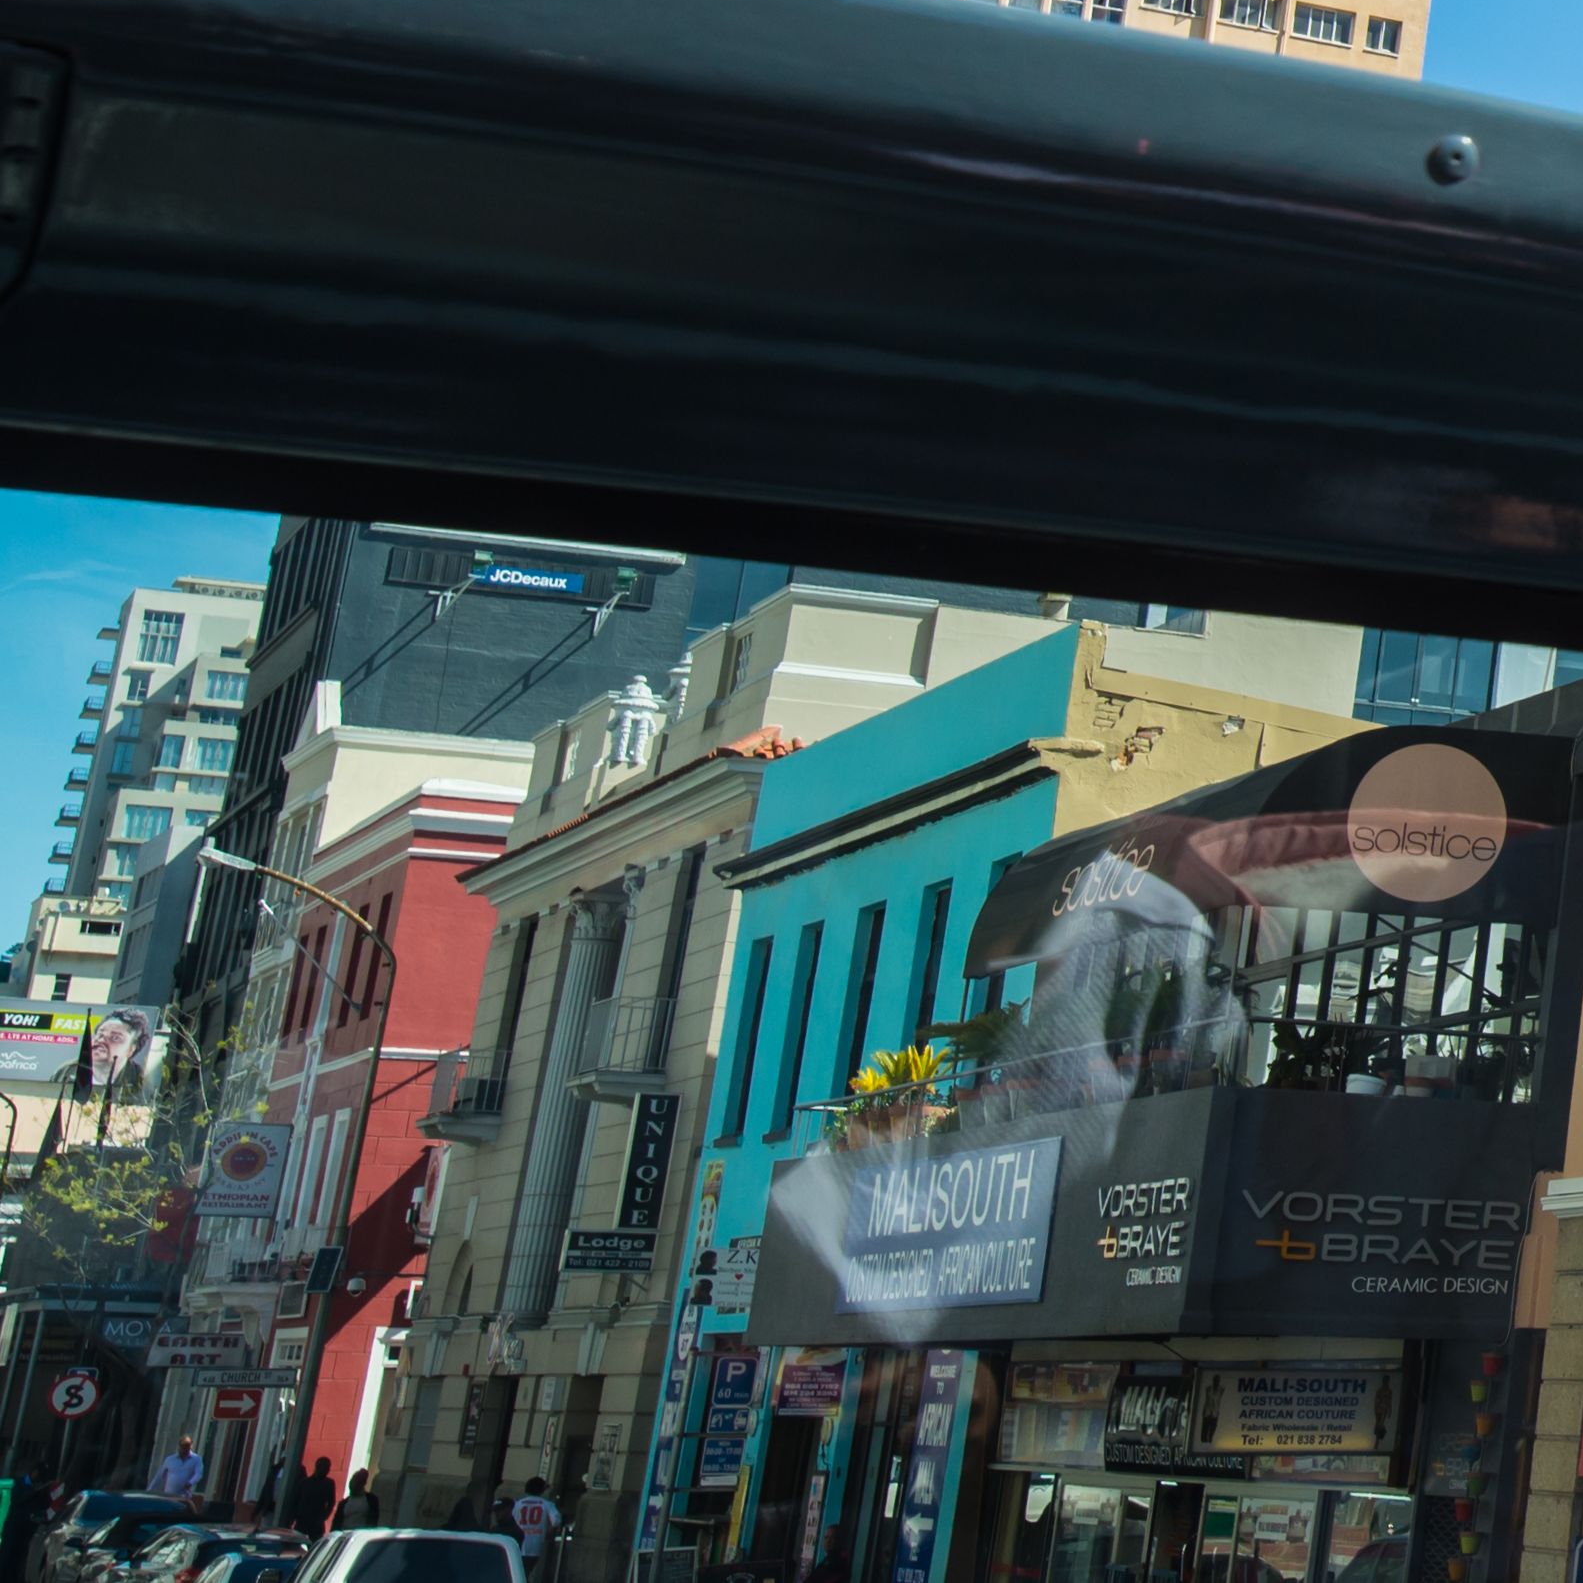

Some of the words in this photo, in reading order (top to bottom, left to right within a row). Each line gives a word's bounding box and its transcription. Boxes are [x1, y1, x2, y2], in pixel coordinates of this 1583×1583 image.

[490, 569, 568, 590] JCDecaux
[1350, 821, 1499, 863] solstice
[4, 1013, 40, 1026] YOH!
[631, 1098, 669, 1226] UNIQUE
[867, 1149, 1036, 1238] MALISOUTH
[1098, 1177, 1190, 1218] VORSTER
[1242, 1189, 1522, 1231] VORSTER
[577, 1235, 646, 1251] Lodge
[1117, 1220, 1185, 1258] BRAYE
[1321, 1233, 1516, 1271] BRAYE
[845, 1254, 887, 1303] CUSTOM
[882, 1248, 934, 1299] DESIGNED
[936, 1242, 982, 1297] AFRICAN
[1351, 1275, 1438, 1294] CERAMIC
[1443, 1276, 1509, 1295] DESIGN
[157, 1336, 239, 1348] EARTH
[170, 1353, 223, 1365] ART
[220, 1371, 262, 1384] CHURCH
[726, 1361, 747, 1383] P
[716, 1387, 732, 1399] 60
[1237, 1377, 1367, 1394] MALI-SOUTH
[63, 1384, 83, 1408] S
[1240, 1396, 1293, 1407] CUSTOM
[1296, 1396, 1359, 1407] DESIGNED
[1238, 1409, 1294, 1420] AFRICAN
[1299, 1409, 1356, 1420] COUTURE
[1241, 1423, 1269, 1432] Fabric
[1272, 1423, 1319, 1432] Wholesale
[1326, 1423, 1353, 1432] Retail
[1241, 1434, 1264, 1446] Tel:
[1276, 1434, 1294, 1445] 021
[1318, 1434, 1342, 1445] 2784
[1105, 1443, 1135, 1463] CUSTOM
[1135, 1445, 1171, 1466] DESIGNED
[519, 1505, 544, 1525] 10
